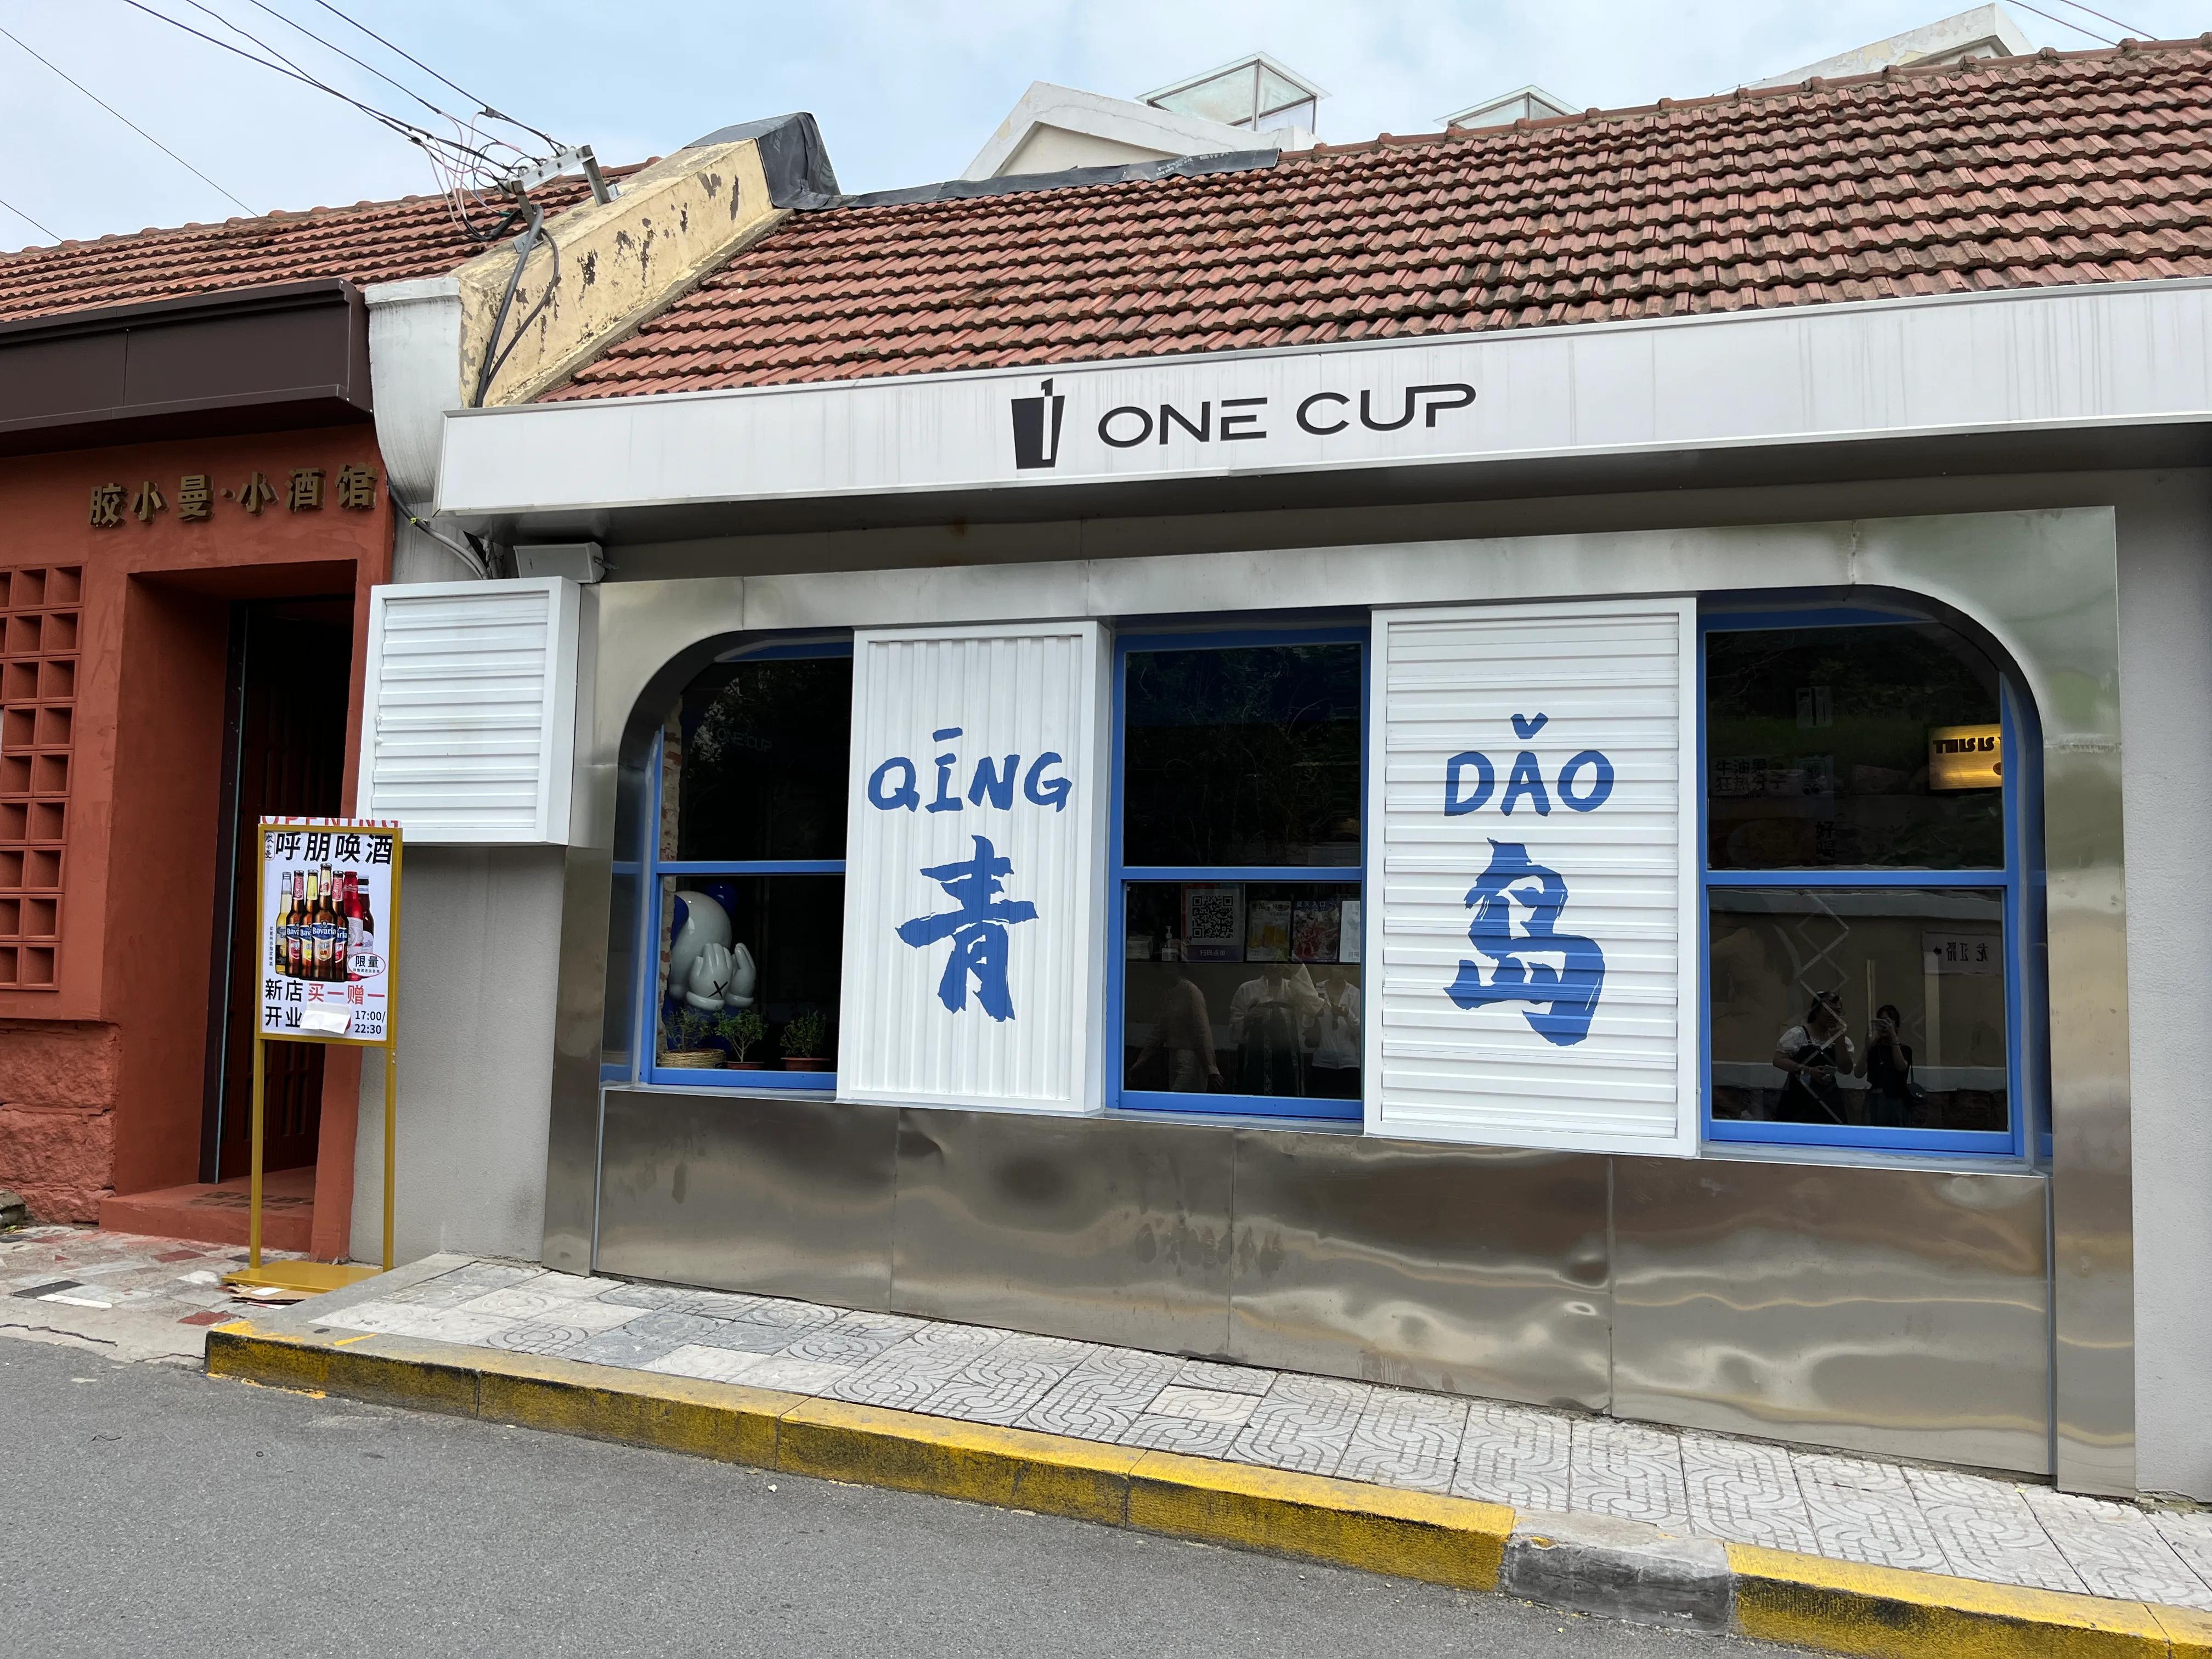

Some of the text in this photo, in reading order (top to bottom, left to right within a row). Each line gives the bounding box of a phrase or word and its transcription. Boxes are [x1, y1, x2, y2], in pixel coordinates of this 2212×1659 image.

[1097, 383, 1476, 448] ONE CUP
[1444, 712, 1615, 816] DǍO
[275, 831, 393, 865] 呼朋唤酒
[312, 927, 336, 935] Bavaria
[895, 834, 1039, 1022] 青
[1443, 837, 1606, 1046] 岛
[356, 955, 379, 968] 限量
[266, 978, 385, 1005] 新店 买一赠一
[266, 1006, 302, 1028] 开业
[354, 1024, 381, 1034] 22:30
